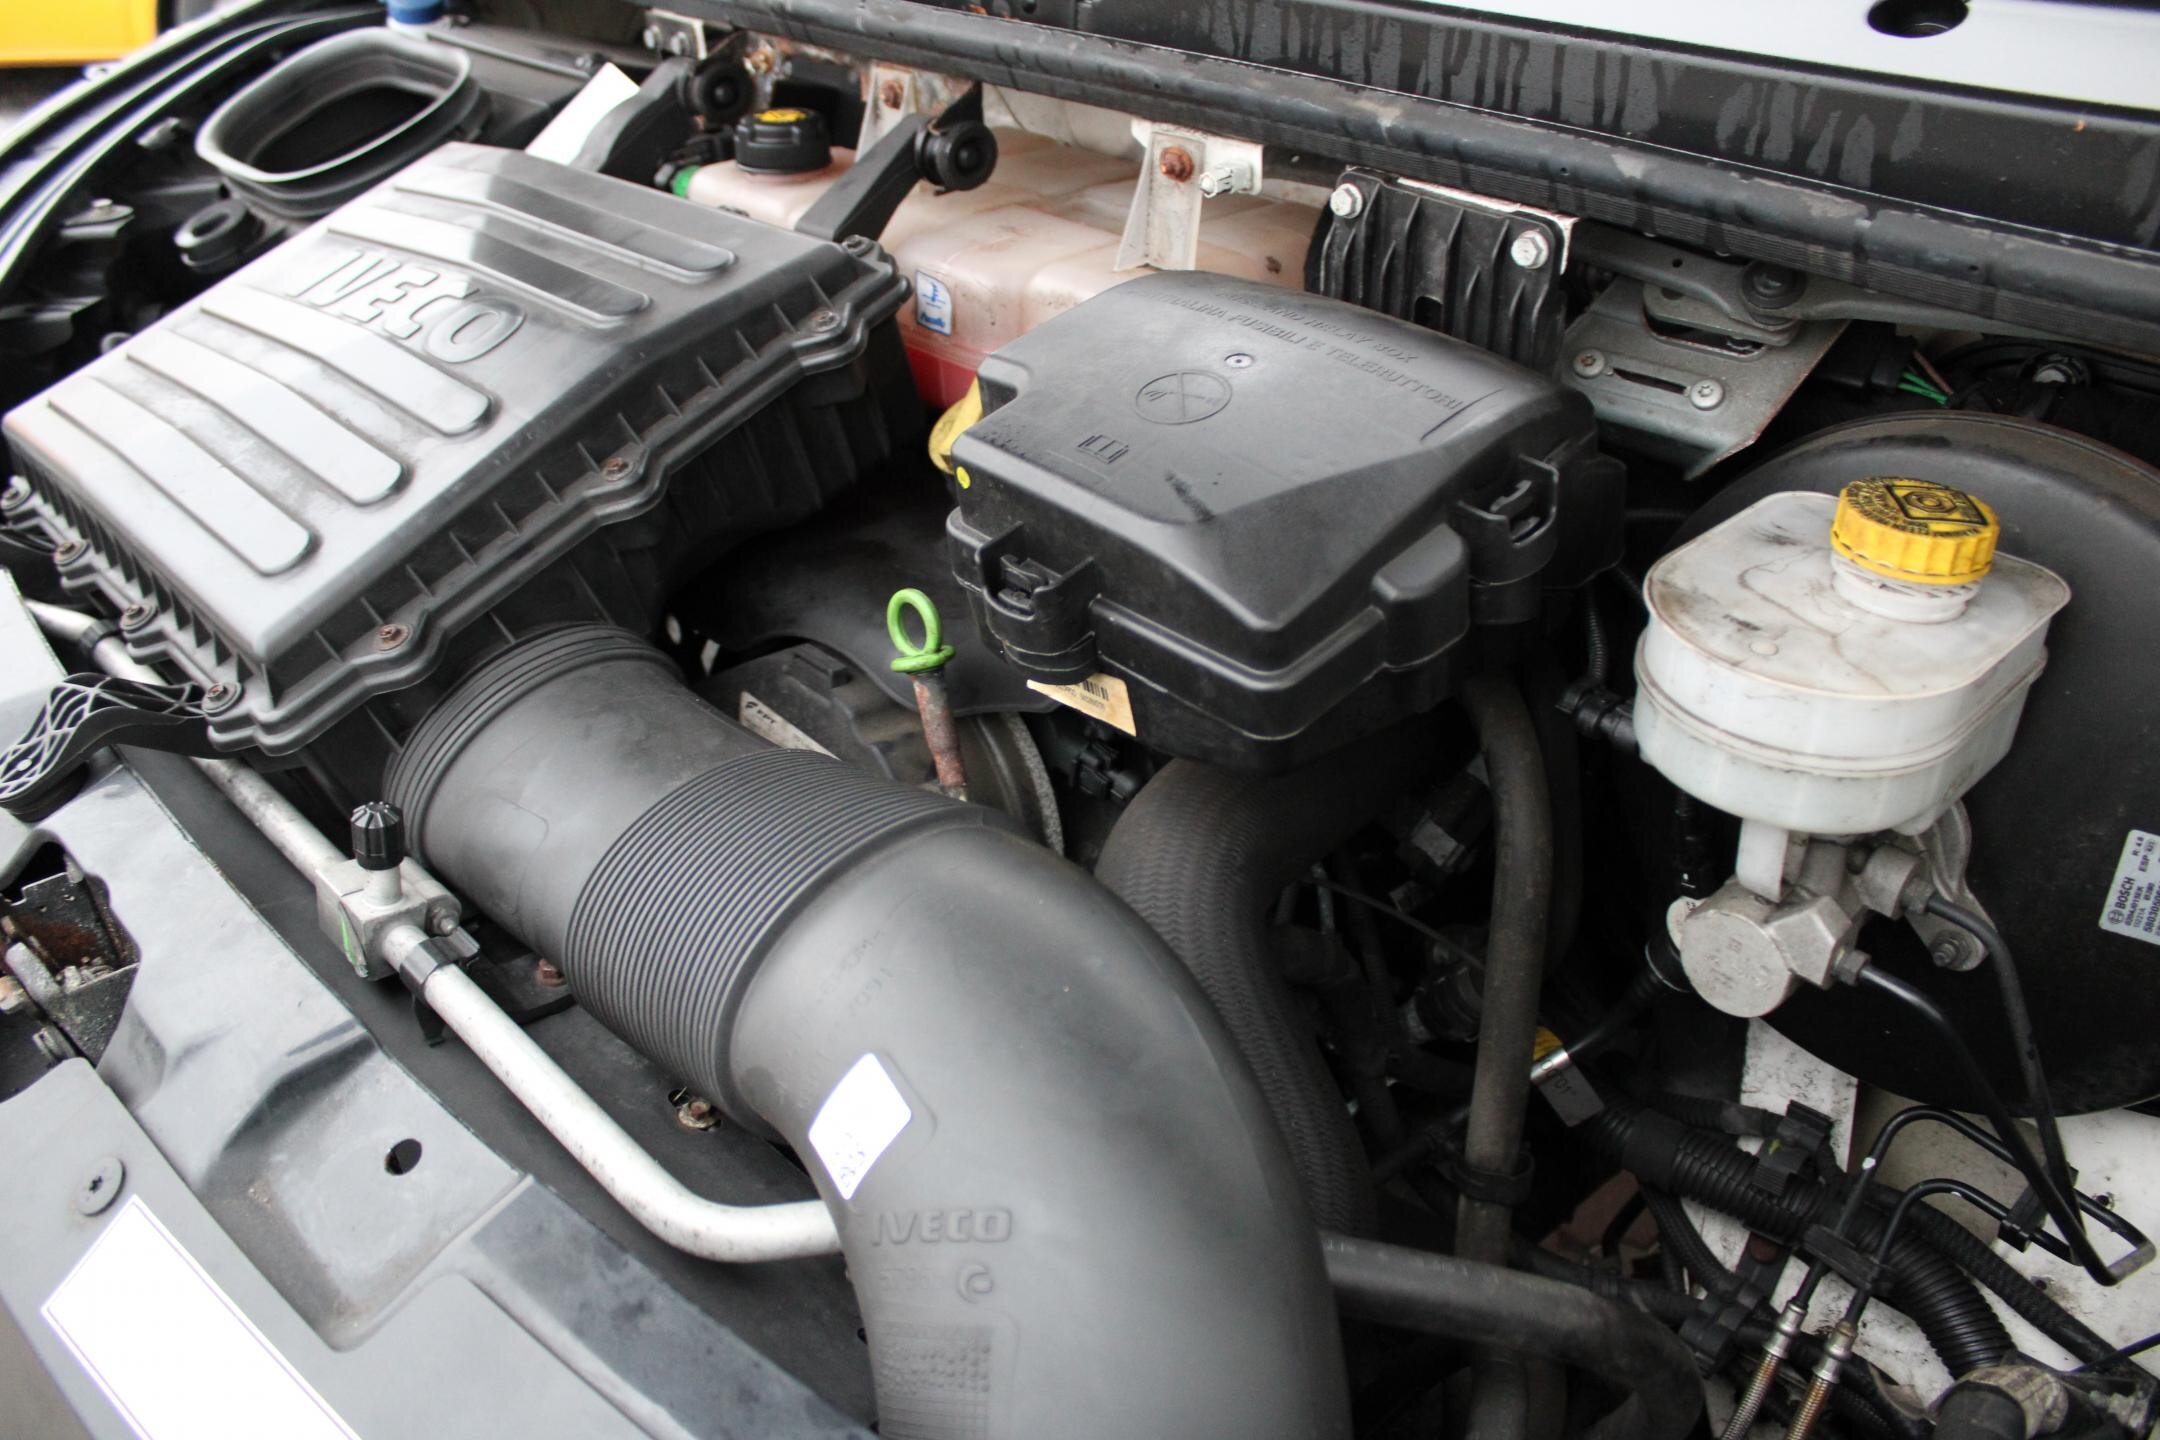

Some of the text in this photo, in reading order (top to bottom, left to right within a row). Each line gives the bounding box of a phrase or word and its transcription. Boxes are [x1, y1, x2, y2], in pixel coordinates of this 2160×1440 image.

[286, 250, 527, 364] IVECO
[1227, 314, 1308, 344] FUSIBILI
[1326, 348, 1463, 409] TELERUTTORI
[2116, 877, 2135, 909] BOSCH
[871, 1207, 1013, 1247] IVECO
